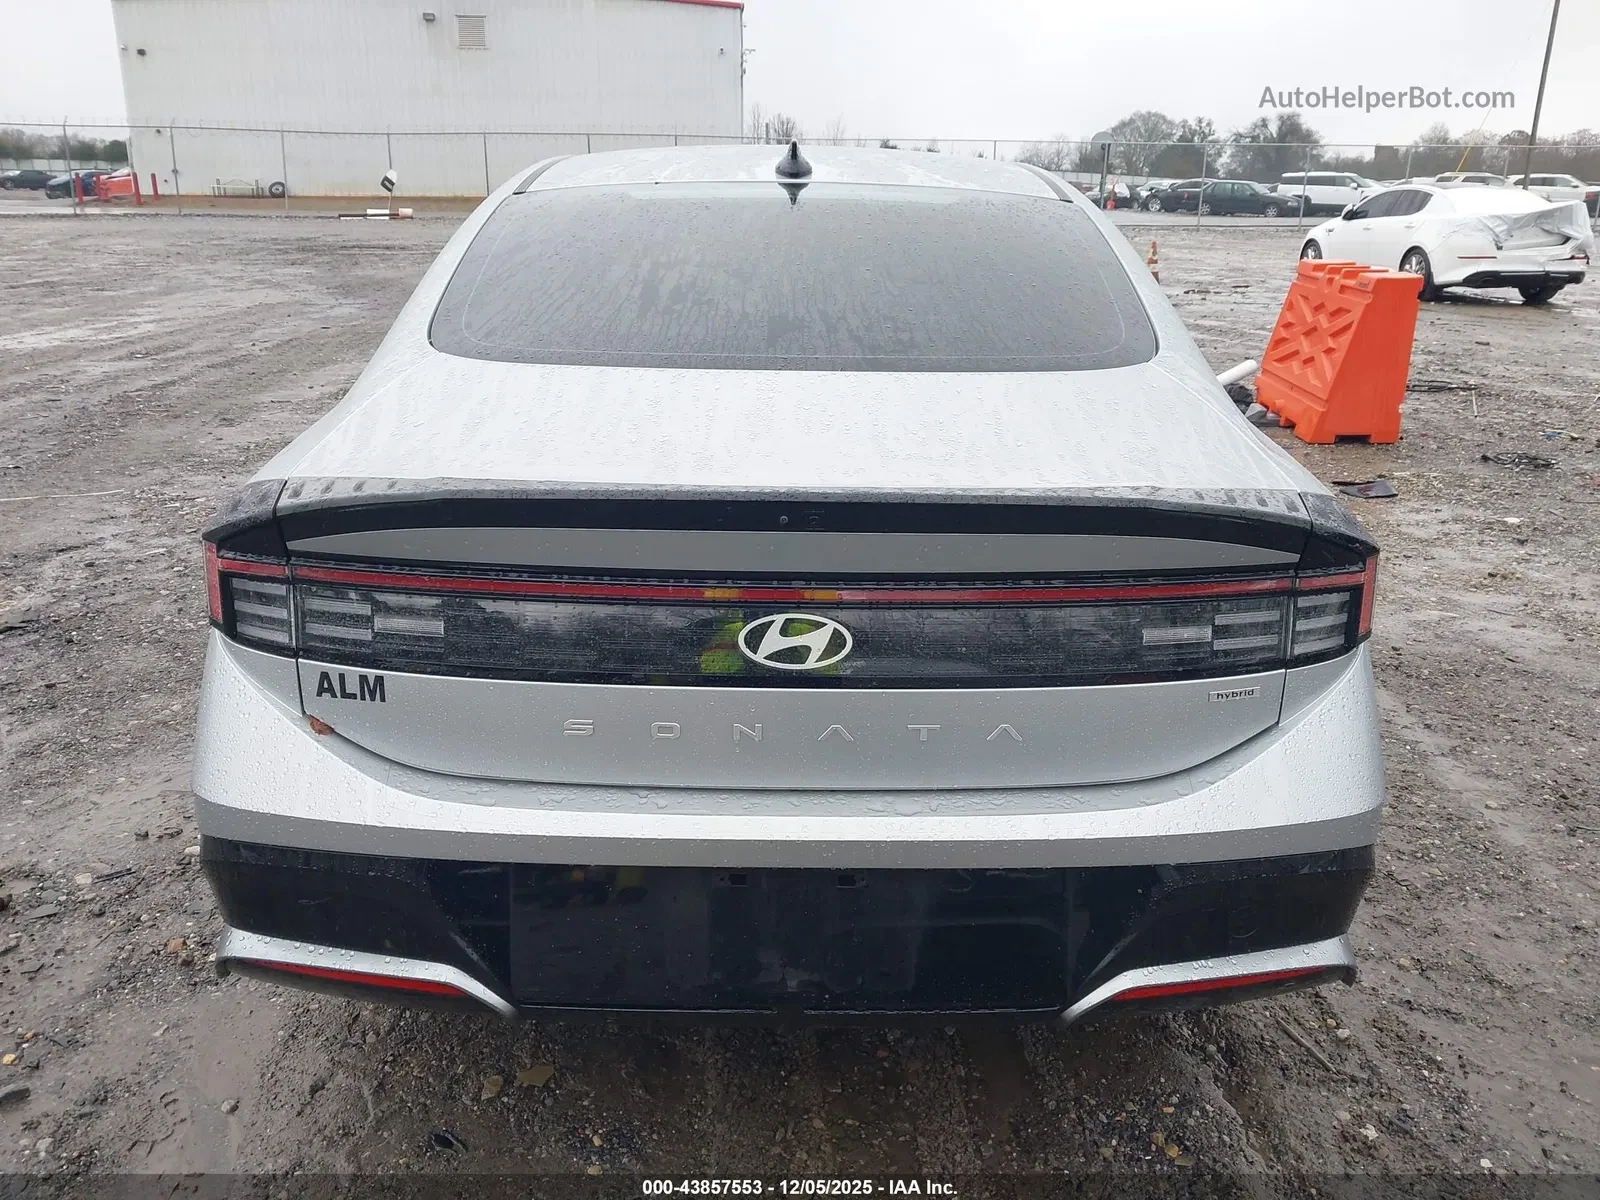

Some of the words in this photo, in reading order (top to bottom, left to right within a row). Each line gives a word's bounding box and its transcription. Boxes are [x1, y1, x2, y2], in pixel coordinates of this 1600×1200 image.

[315, 671, 387, 702] ALM
[1216, 688, 1255, 700] hybrid
[562, 719, 1023, 742] SONATA
